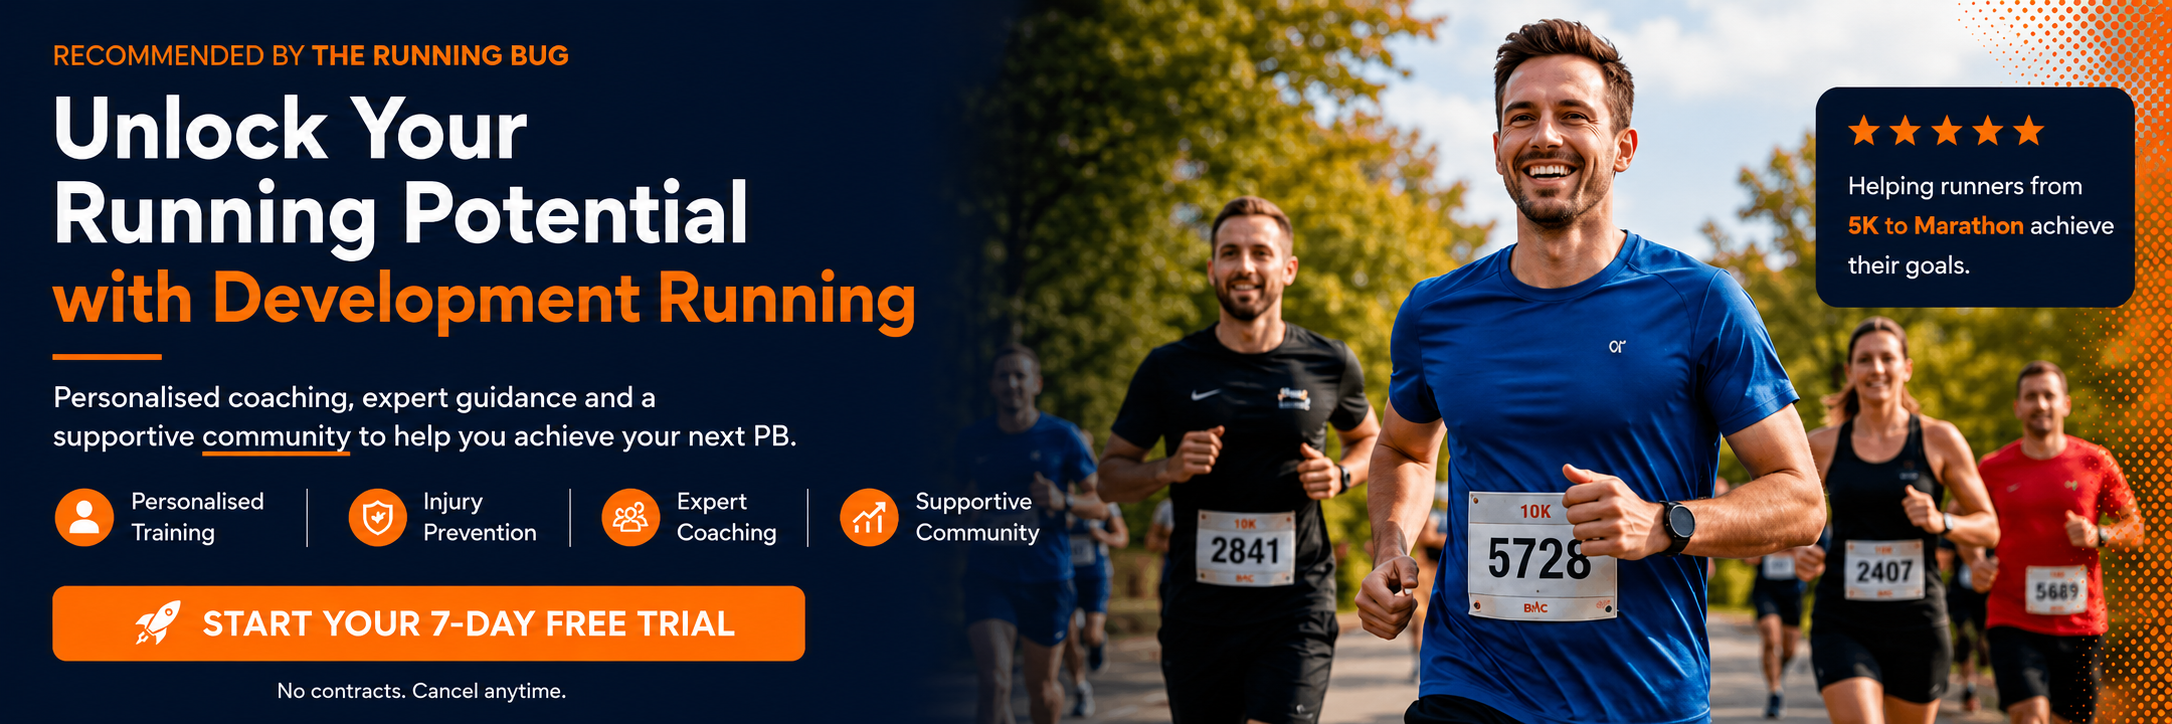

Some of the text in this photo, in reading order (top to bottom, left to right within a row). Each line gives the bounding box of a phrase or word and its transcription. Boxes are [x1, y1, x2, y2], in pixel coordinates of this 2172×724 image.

[1521, 504, 1551, 518] 10K
[1234, 518, 1257, 530] 10K
[1211, 537, 1279, 564] 2841
[1488, 537, 1591, 579] 5728
[1856, 559, 1913, 583] 2407
[2035, 582, 2079, 601] 5689
